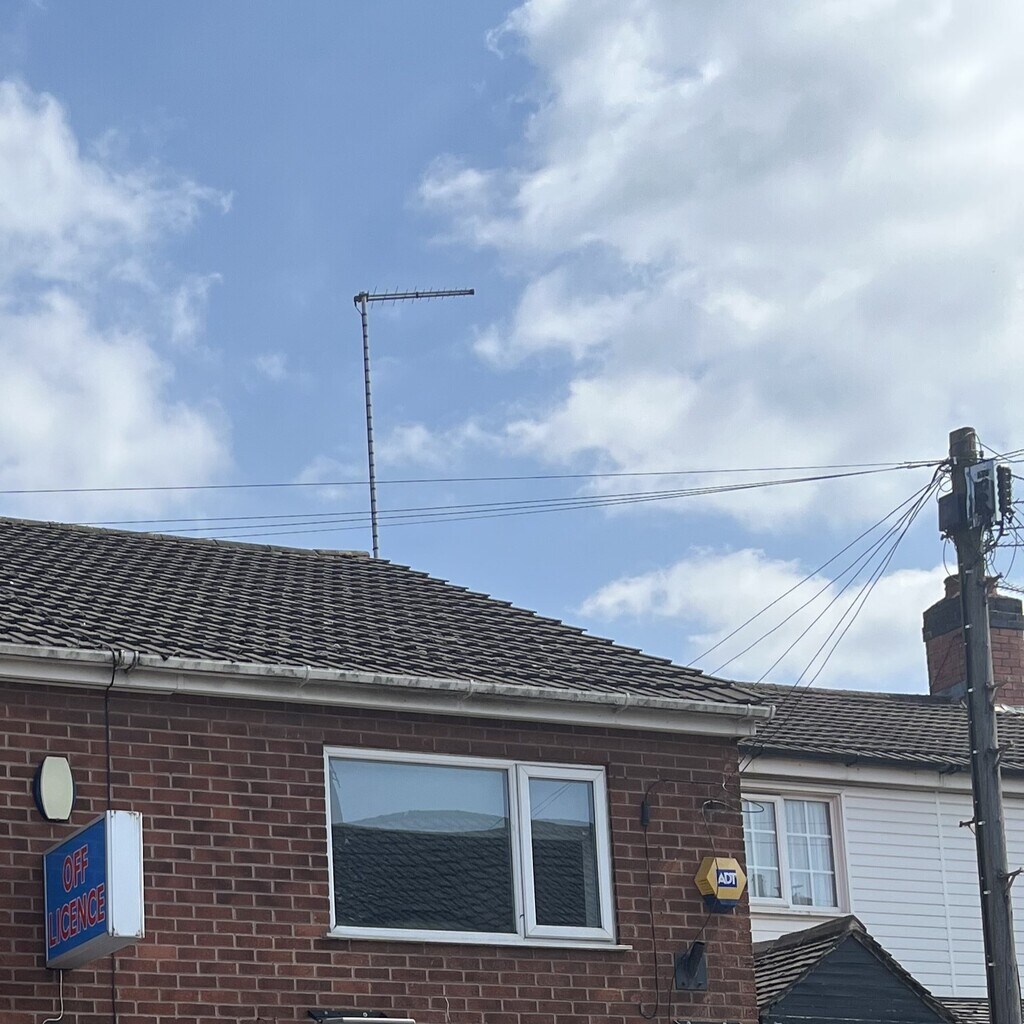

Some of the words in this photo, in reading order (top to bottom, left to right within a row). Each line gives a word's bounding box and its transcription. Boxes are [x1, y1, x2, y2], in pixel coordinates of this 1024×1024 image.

[62, 845, 89, 893] OFF
[718, 872, 736, 885] ADT
[48, 883, 106, 948] LICENCE
